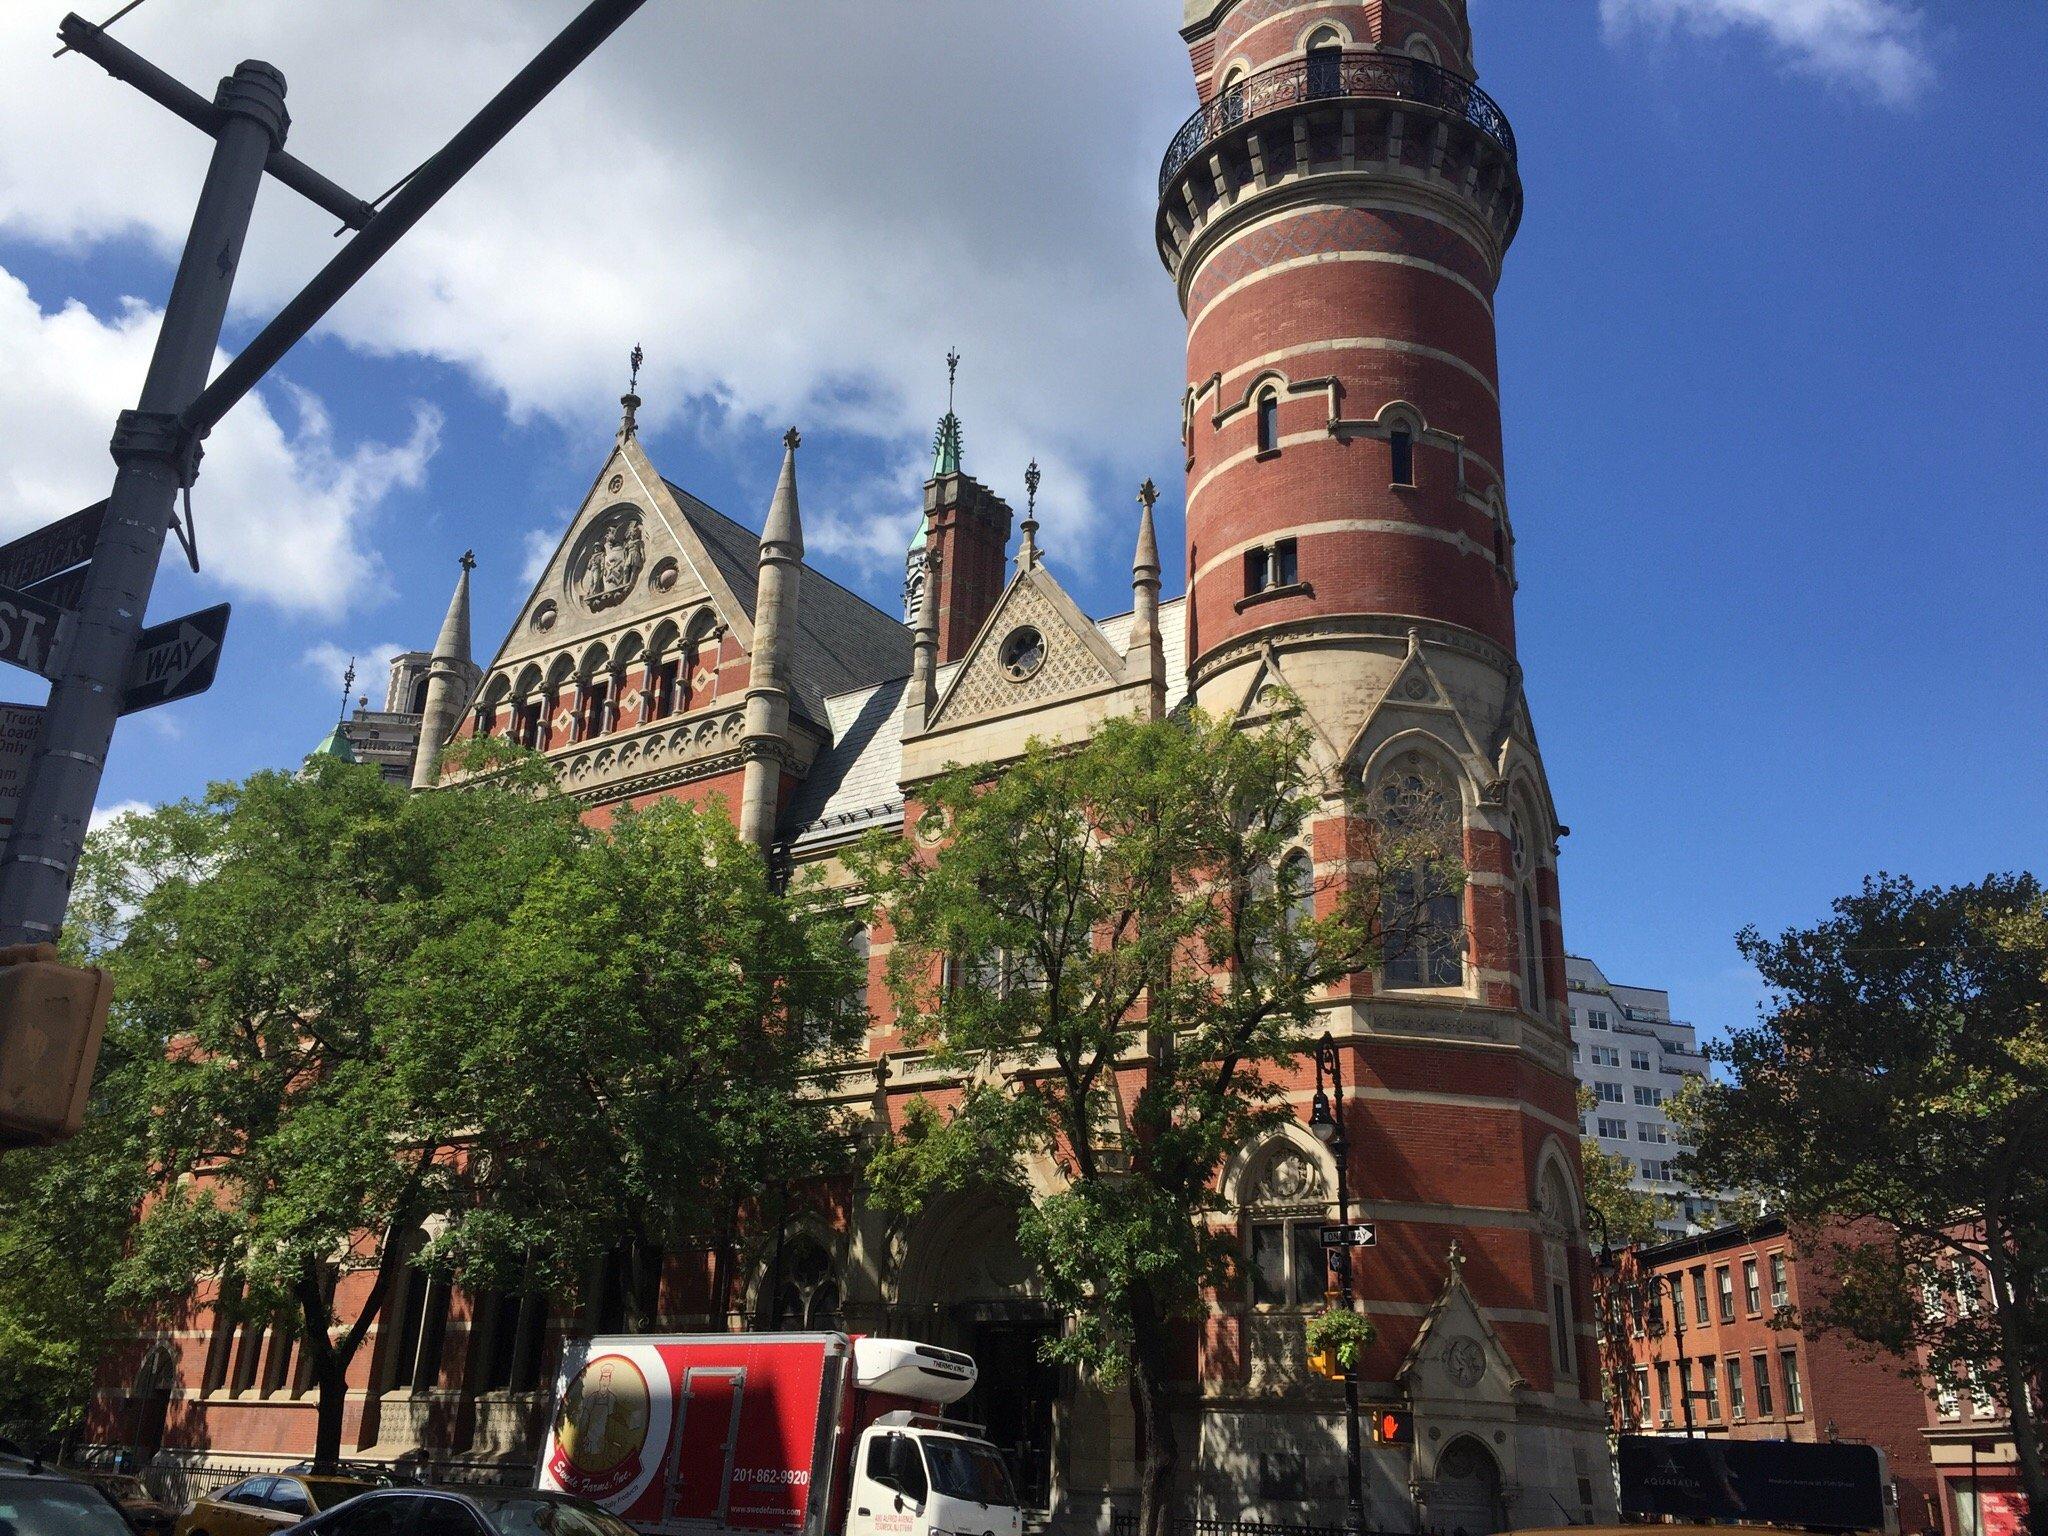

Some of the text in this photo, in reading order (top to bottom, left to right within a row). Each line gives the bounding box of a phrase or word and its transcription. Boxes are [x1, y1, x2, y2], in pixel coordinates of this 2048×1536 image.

[146, 635, 203, 682] WAY
[5, 710, 44, 726] Truck
[933, 1360, 954, 1371] THERMO
[954, 1365, 965, 1373] KING
[554, 1460, 579, 1488] Swede
[613, 1470, 632, 1486] Inc.
[733, 1467, 808, 1485] 201-862-9920
[1643, 1477, 1701, 1488] AQUATALIA
[730, 1505, 801, 1517] www.swedefarms.com
